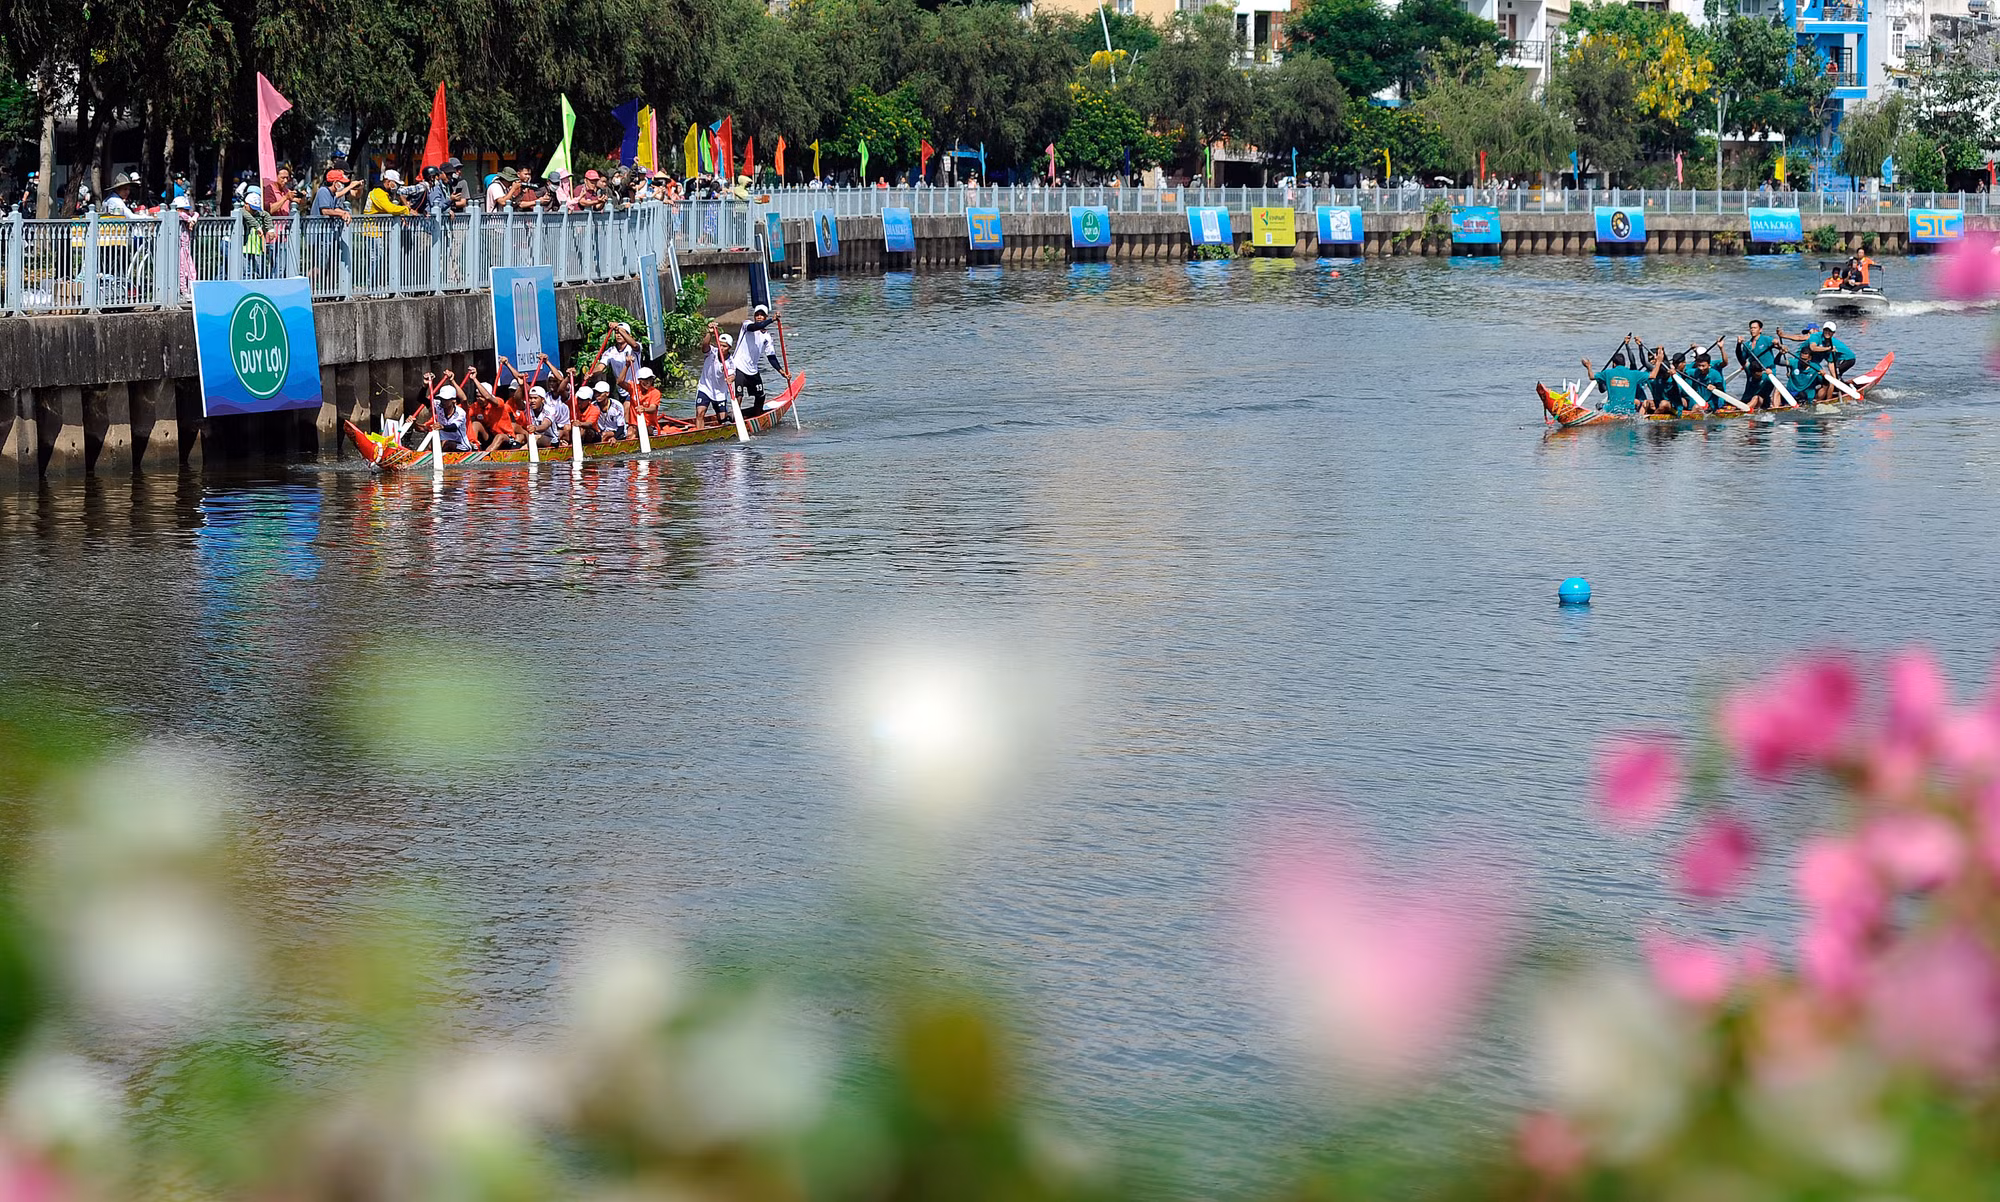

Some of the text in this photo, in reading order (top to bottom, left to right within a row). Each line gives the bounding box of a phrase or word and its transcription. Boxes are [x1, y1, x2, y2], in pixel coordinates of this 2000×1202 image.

[972, 214, 1000, 243] STC
[1916, 214, 1958, 238] STC
[240, 345, 283, 379] DUY LỢI
